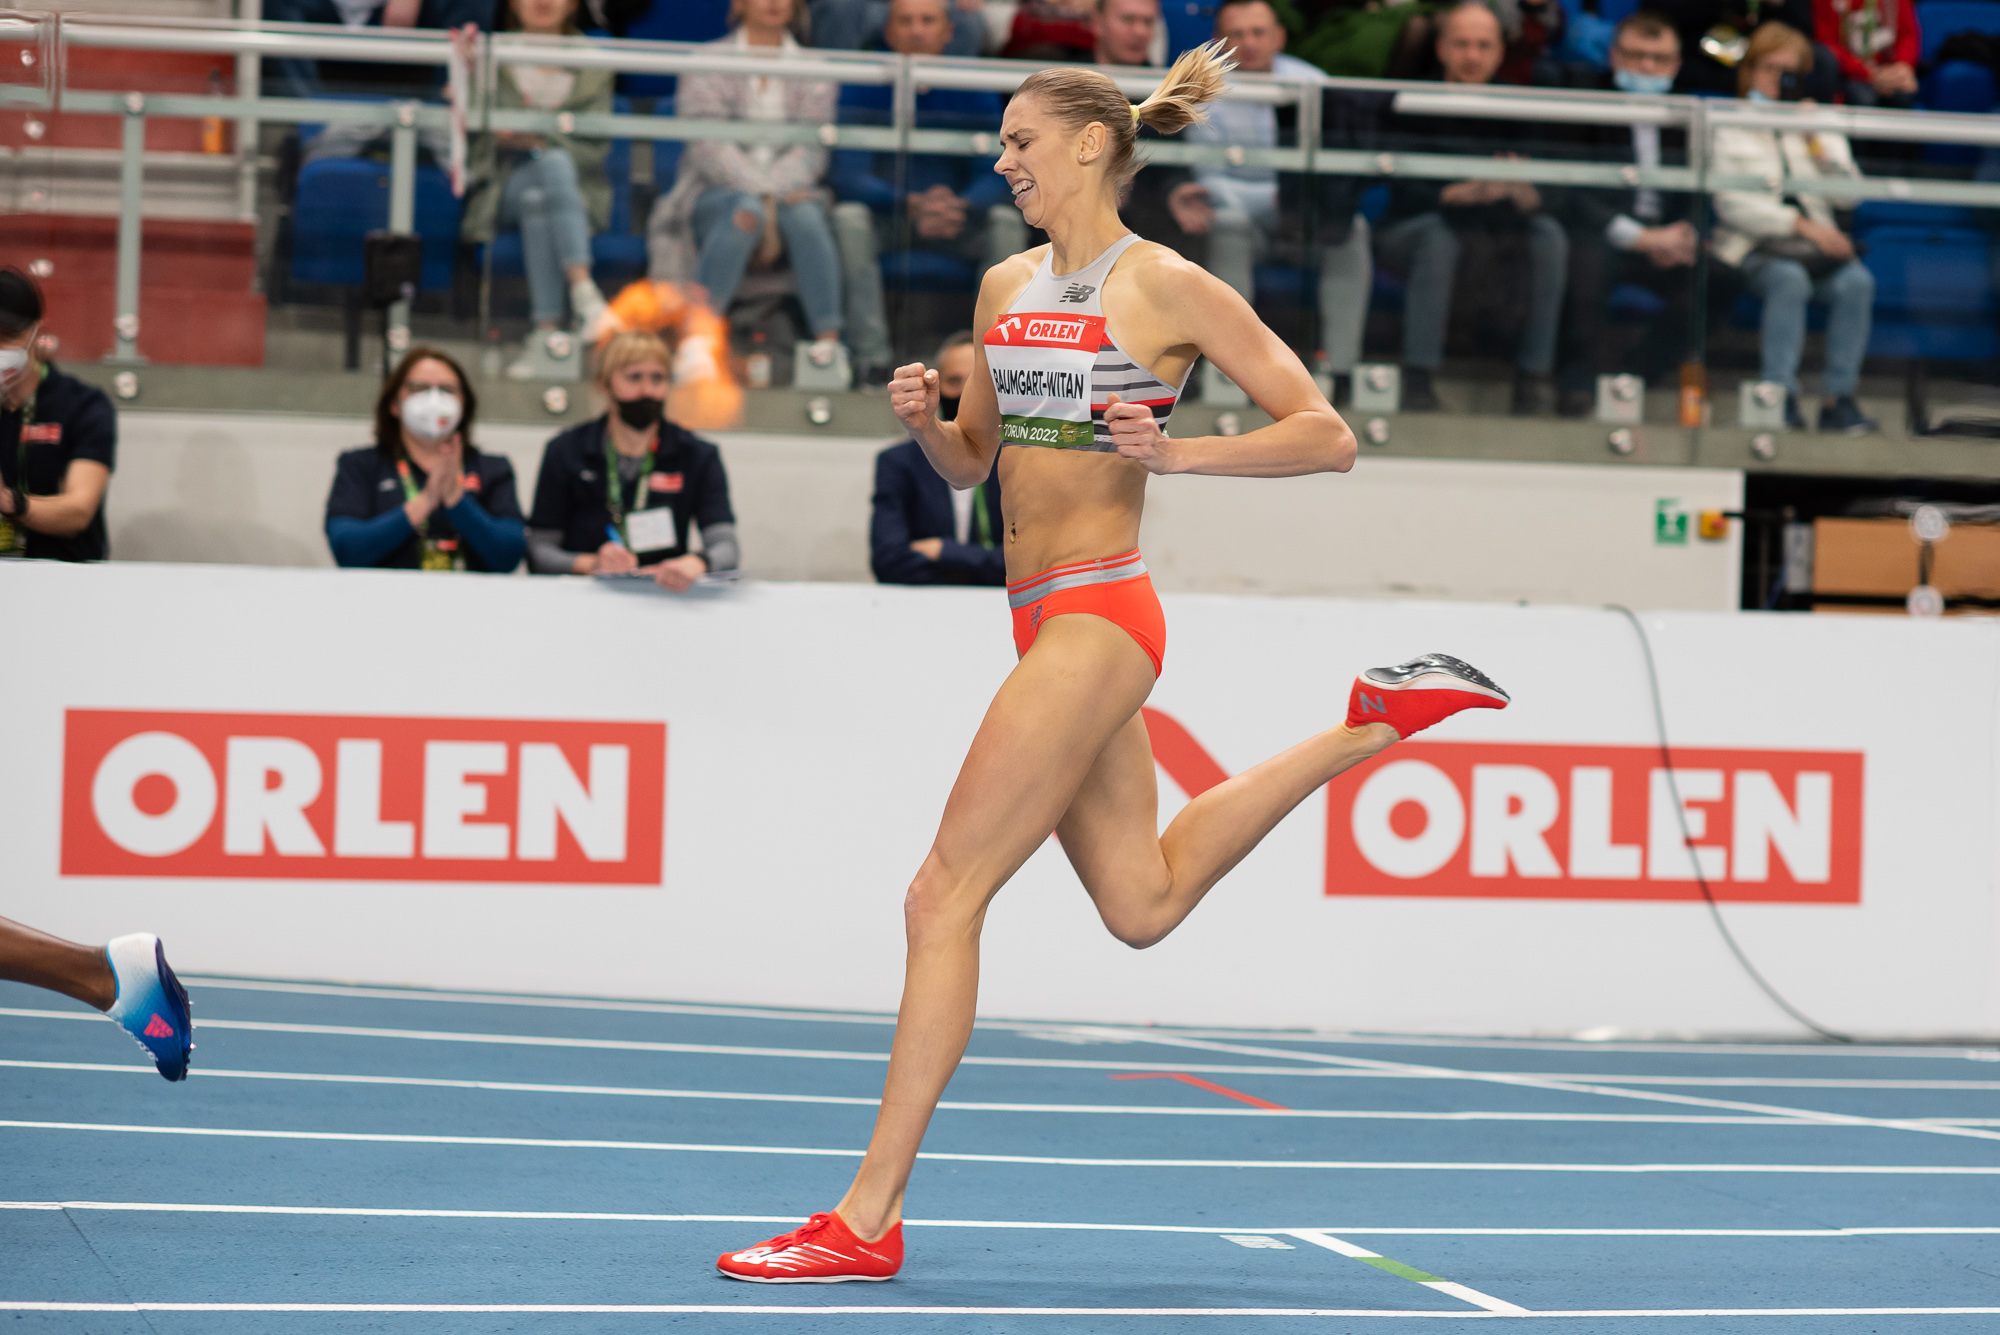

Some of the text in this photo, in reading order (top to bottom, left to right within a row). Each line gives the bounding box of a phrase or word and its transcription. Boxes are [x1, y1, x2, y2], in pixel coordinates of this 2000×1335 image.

[1029, 322, 1081, 340] ORLEN
[992, 368, 1084, 400] BAUMGART-WITAN
[1029, 427, 1059, 443] 2022
[91, 731, 631, 863] ORLEN
[1351, 759, 1832, 884] ORLEN
